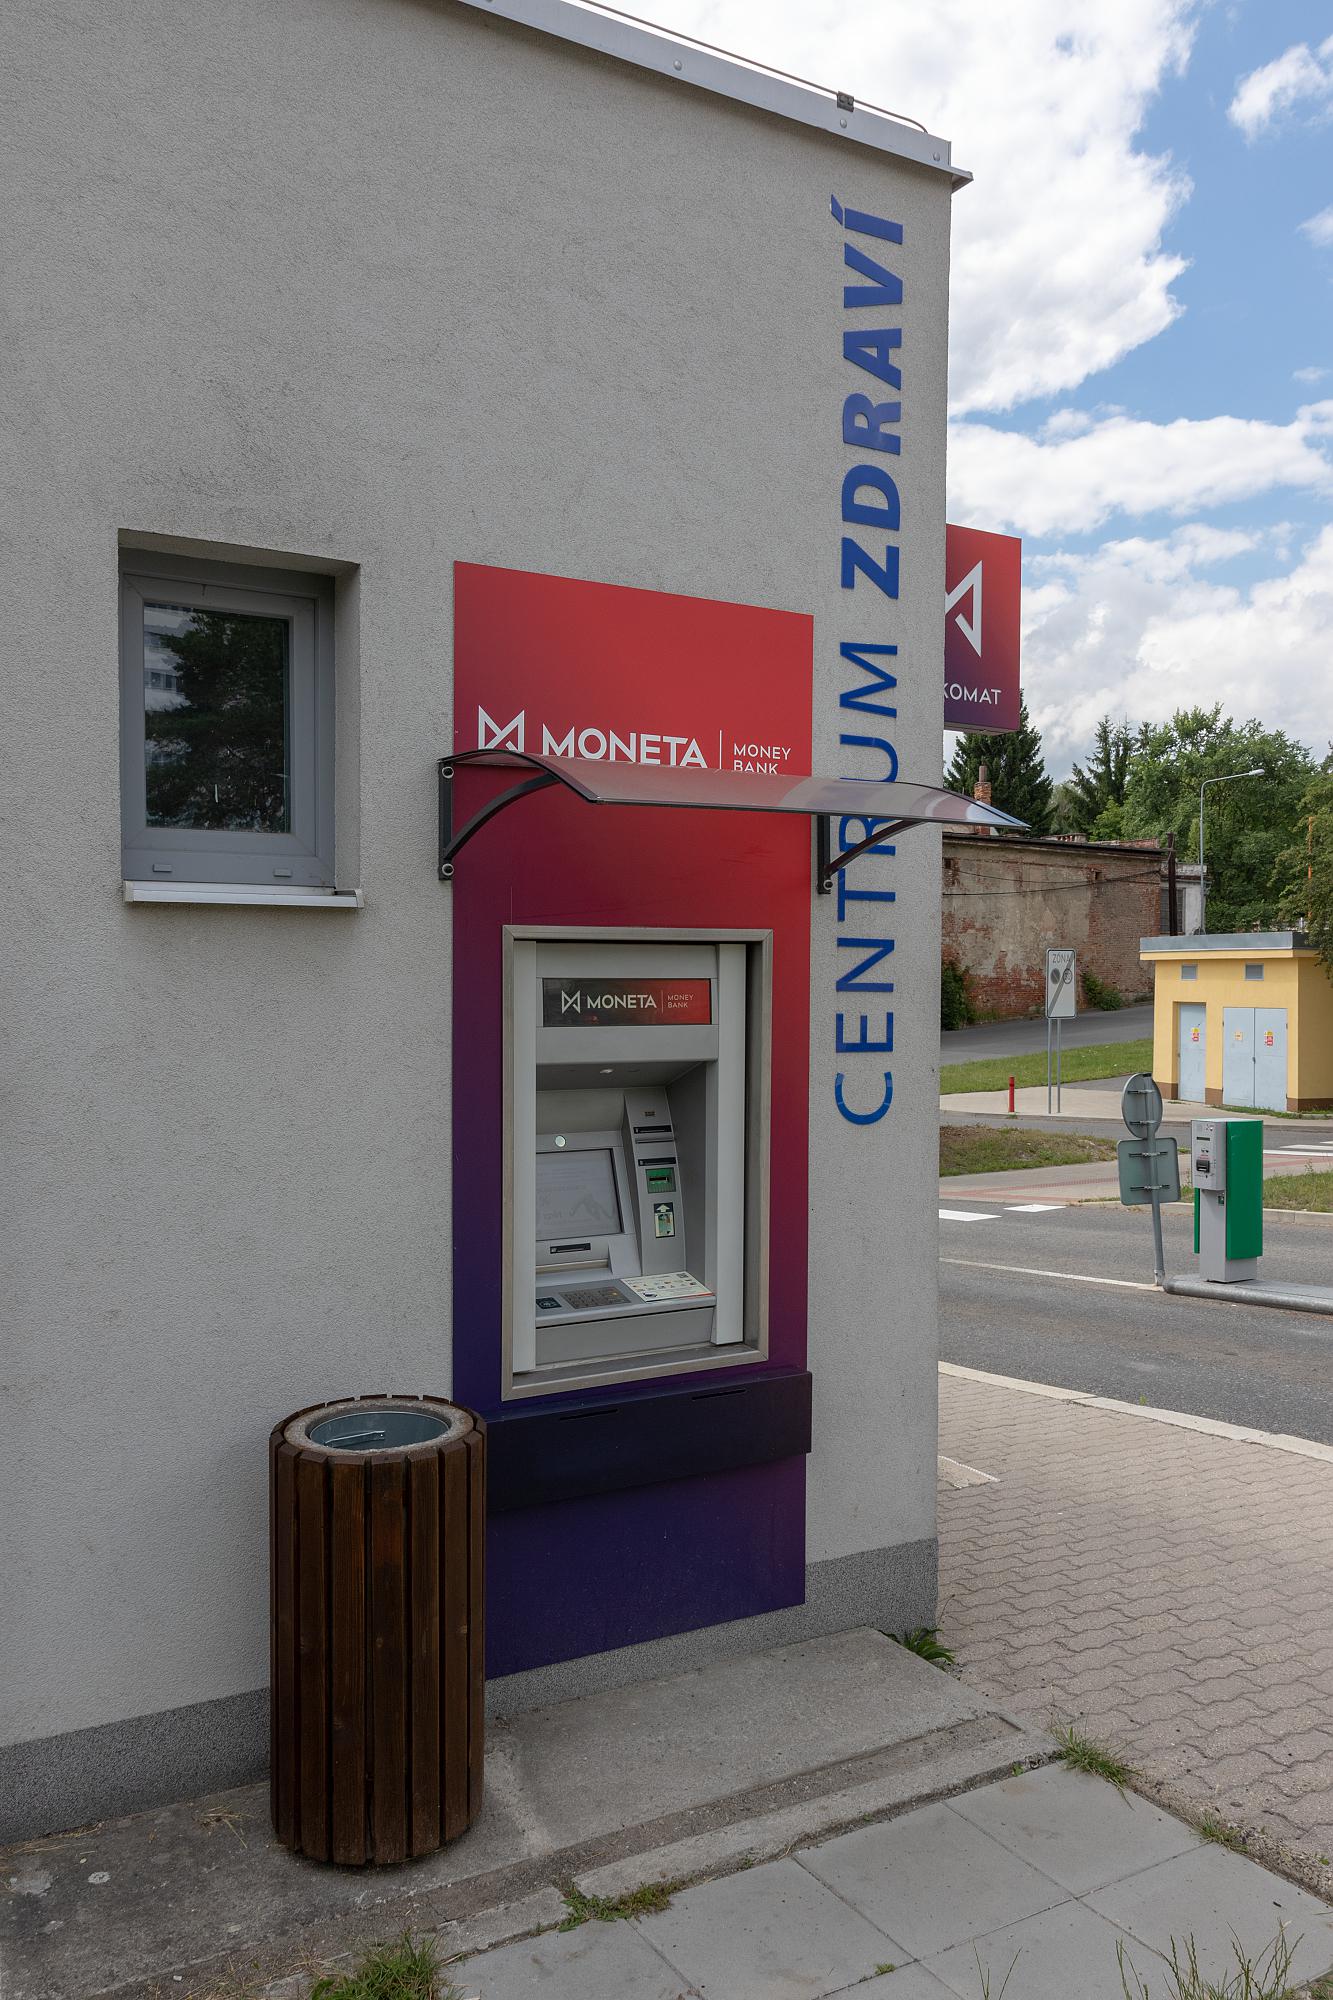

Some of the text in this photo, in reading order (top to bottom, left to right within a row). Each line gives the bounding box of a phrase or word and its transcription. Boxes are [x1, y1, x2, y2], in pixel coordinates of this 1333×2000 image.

[830, 194, 904, 1126] CENTRUM ZDRAVÍ
[542, 722, 708, 769] MONETA
[733, 743, 792, 761] MONEY
[733, 760, 779, 775] BANK
[587, 994, 657, 1009] MONETA
[667, 1001, 688, 1009] BANK
